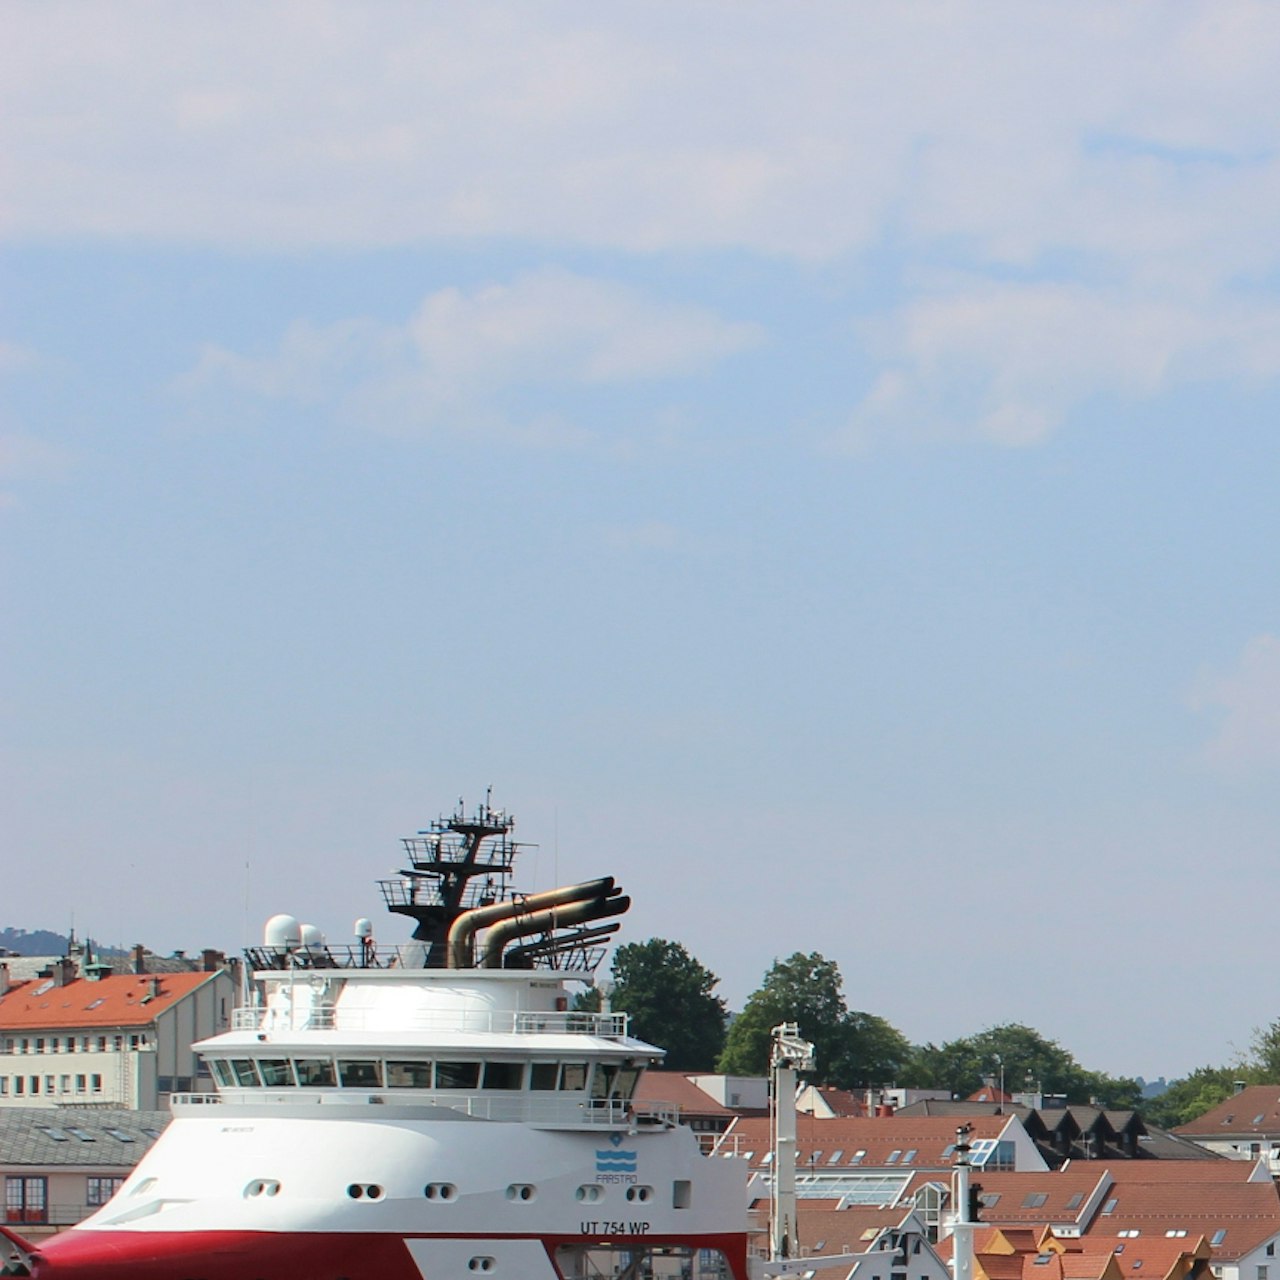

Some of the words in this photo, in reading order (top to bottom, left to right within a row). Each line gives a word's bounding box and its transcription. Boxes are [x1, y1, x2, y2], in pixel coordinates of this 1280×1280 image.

[581, 1221, 599, 1235] UT
[603, 1221, 625, 1235] 754
[629, 1221, 650, 1235] WP
